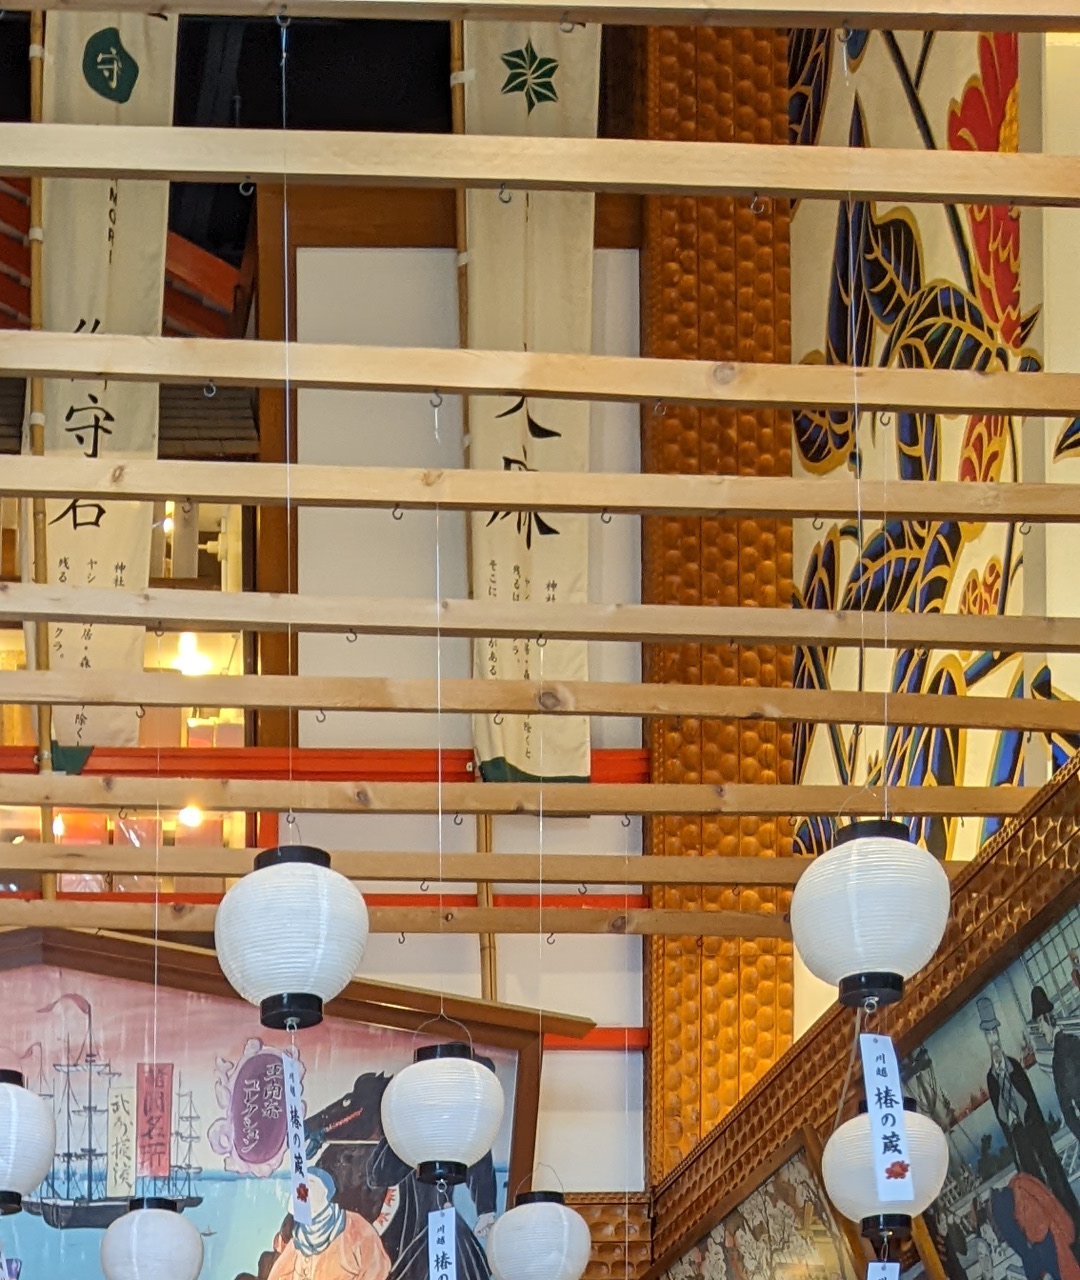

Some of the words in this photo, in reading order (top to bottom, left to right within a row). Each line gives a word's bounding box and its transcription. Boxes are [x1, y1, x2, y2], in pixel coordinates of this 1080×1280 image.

[97, 47, 122, 89] 守
[874, 1085, 902, 1156] 椿の蔵
